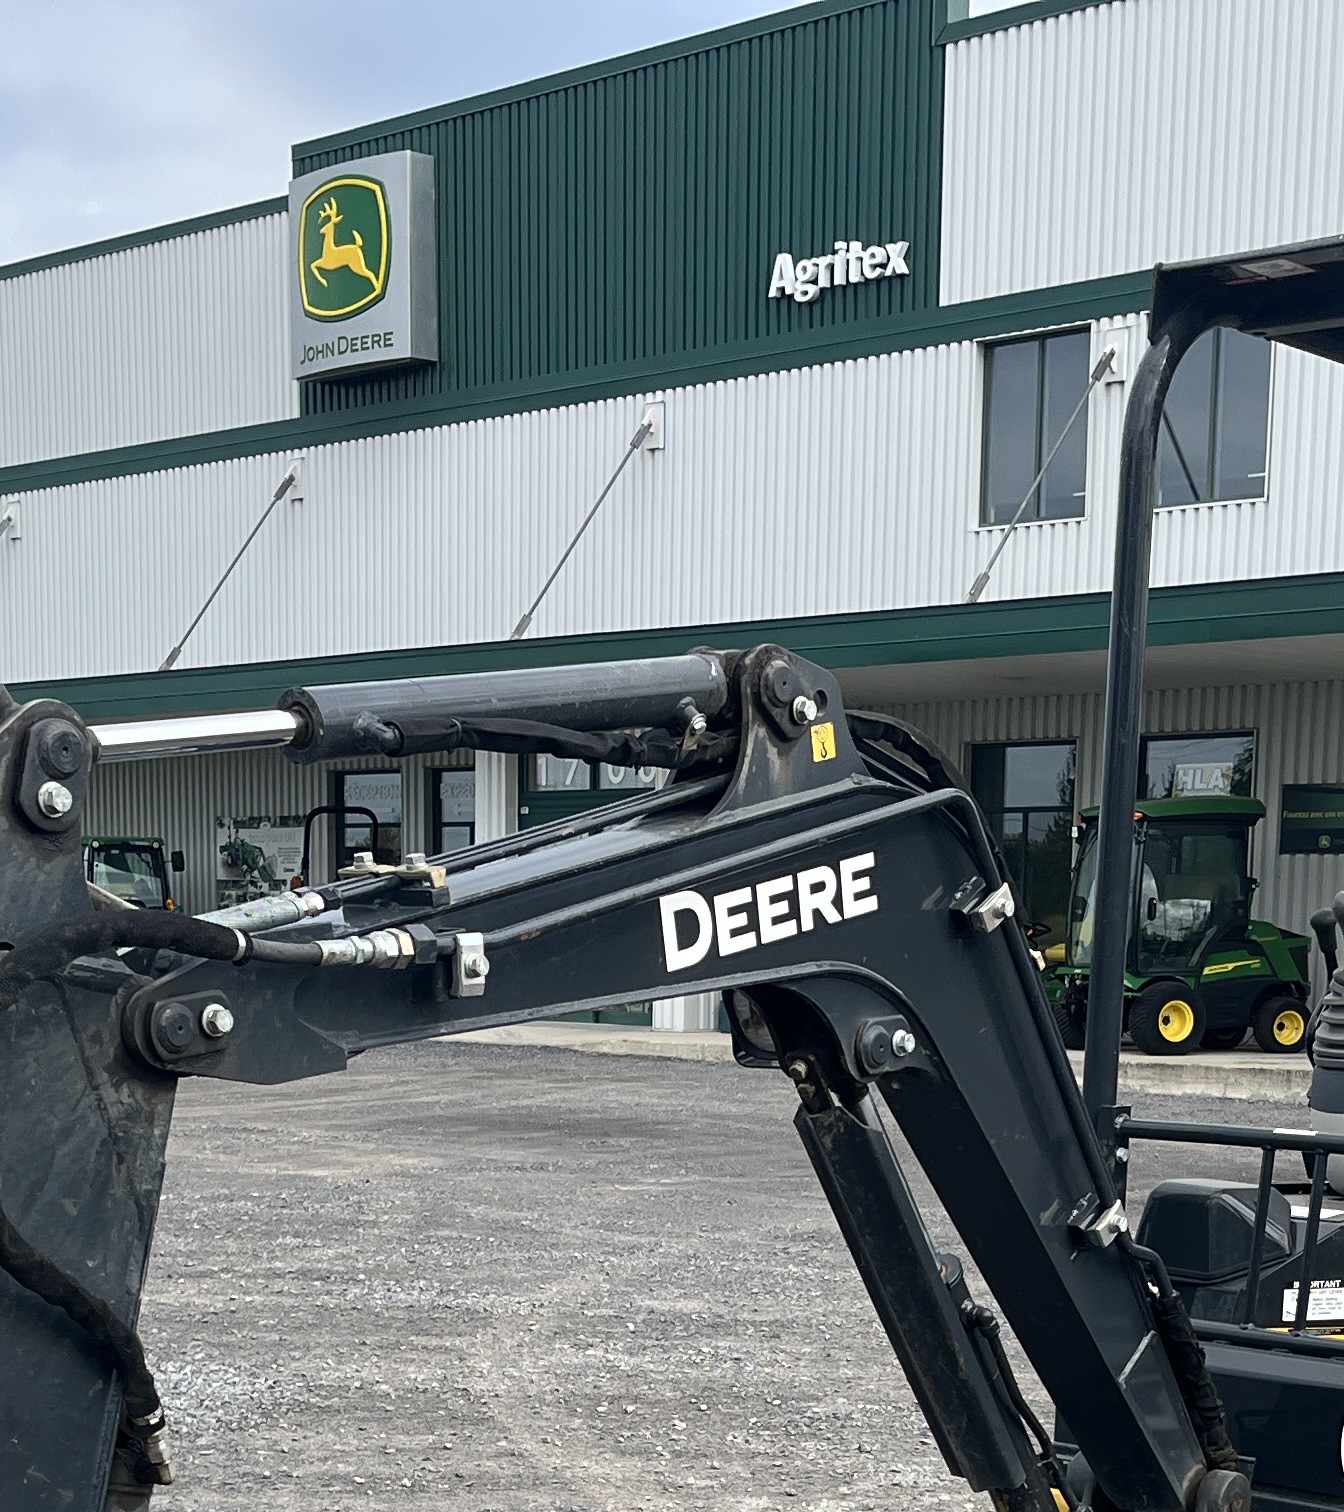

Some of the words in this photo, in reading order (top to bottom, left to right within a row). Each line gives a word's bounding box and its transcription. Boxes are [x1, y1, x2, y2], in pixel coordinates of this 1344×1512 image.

[768, 241, 910, 302] Agritex
[300, 341, 335, 365] JOHN
[337, 331, 394, 355] DEERE
[1177, 768, 1224, 790] HLA
[659, 851, 879, 973] DEERE
